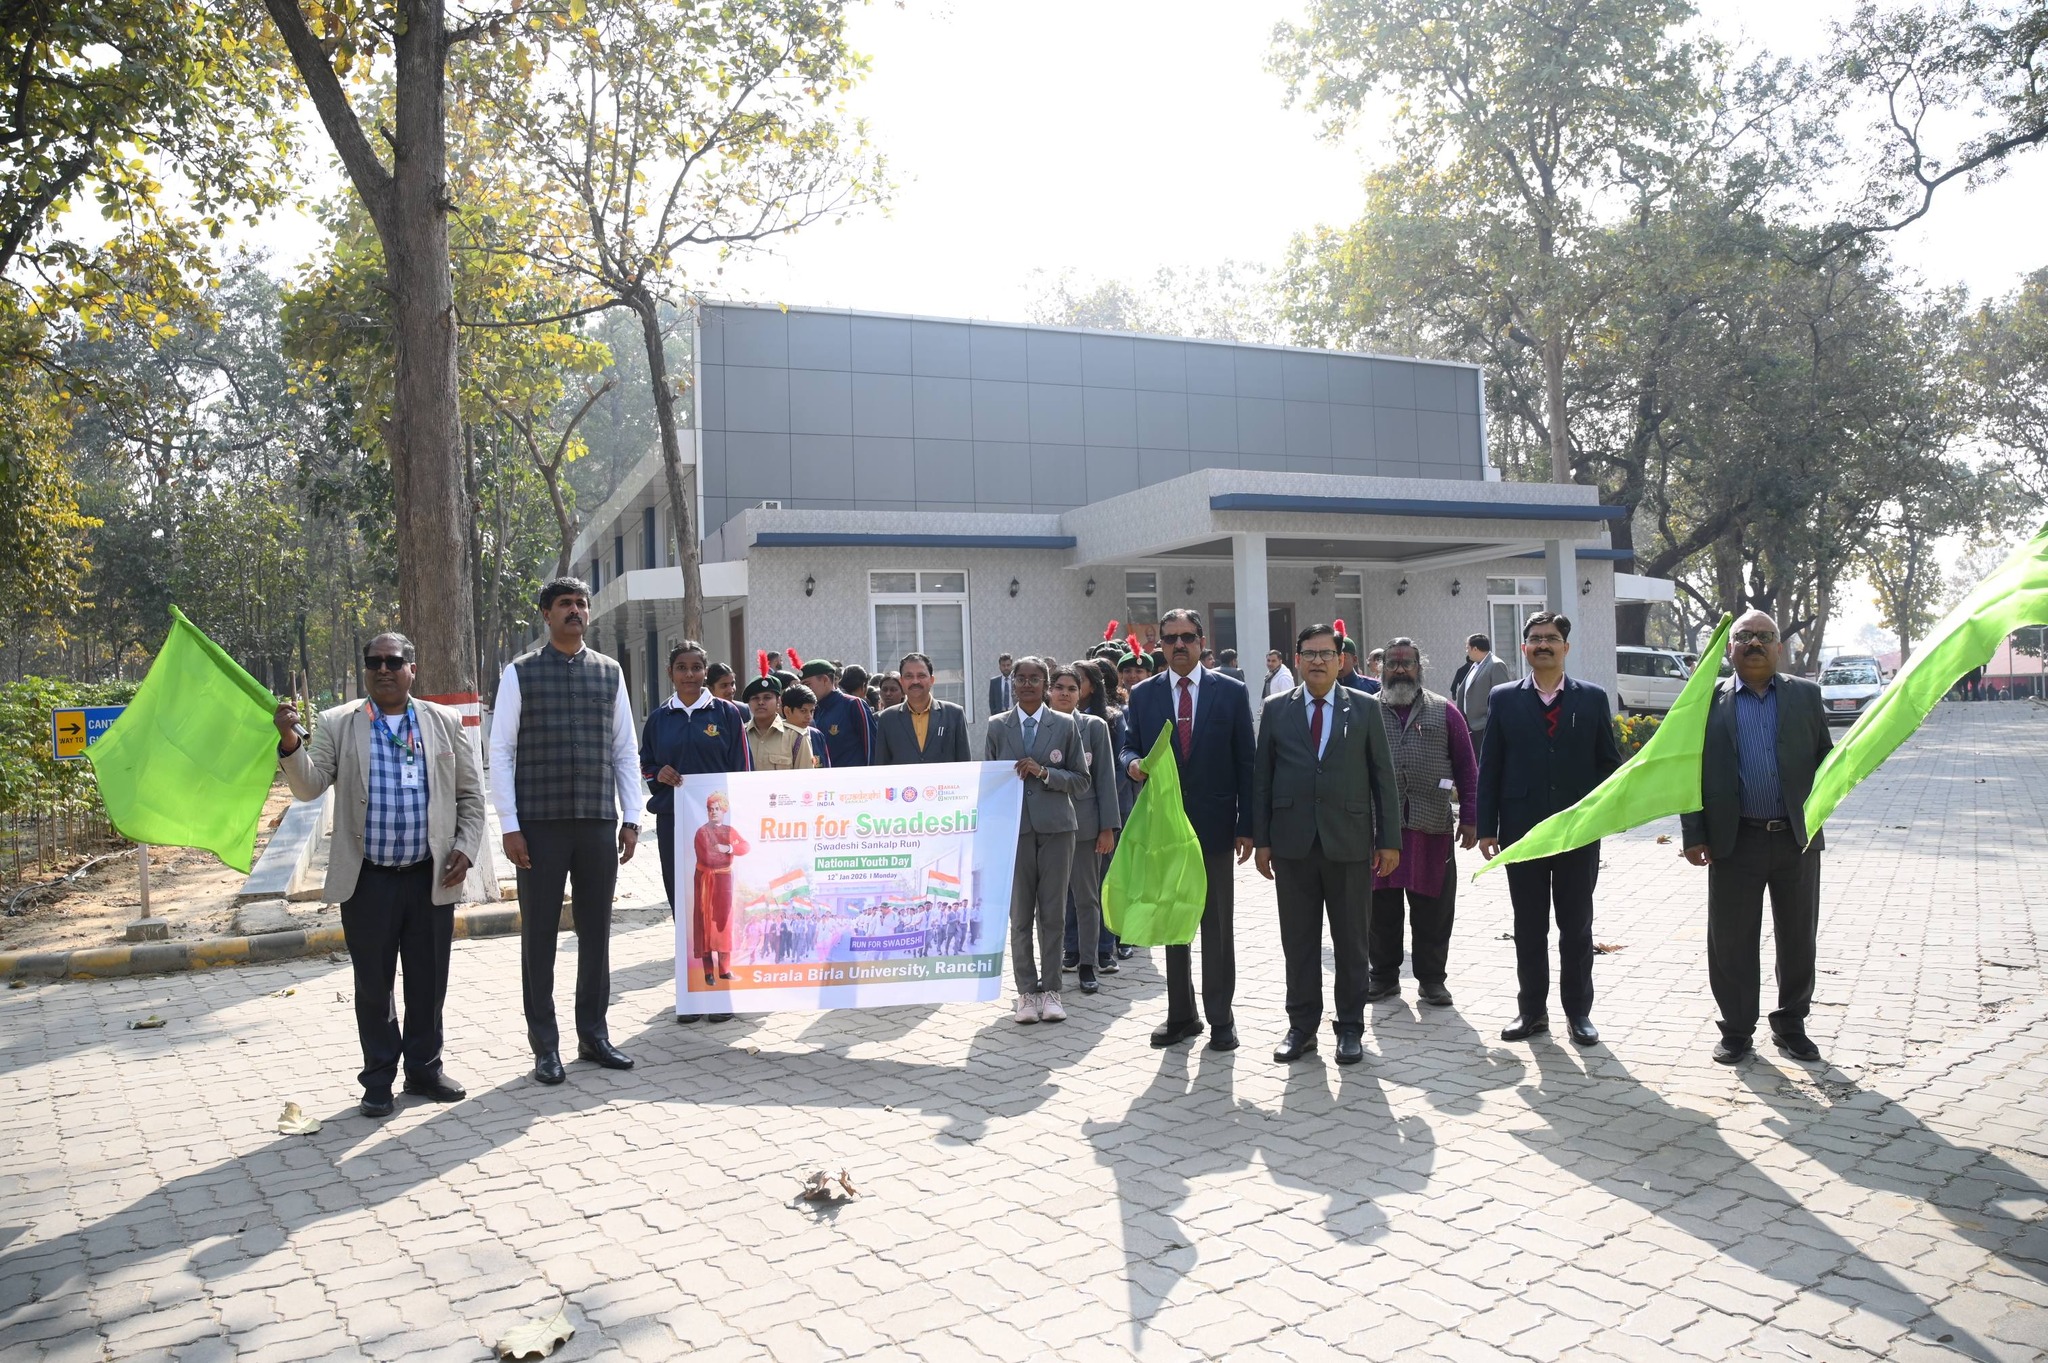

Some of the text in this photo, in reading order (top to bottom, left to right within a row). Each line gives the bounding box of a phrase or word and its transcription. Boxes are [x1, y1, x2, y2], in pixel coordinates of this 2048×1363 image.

[88, 718, 117, 729] CANT
[759, 808, 978, 840] Run for Swadeshi
[813, 839, 921, 853] (Swadeshi Sankalp Run)
[817, 856, 910, 869] National Youth Day
[851, 872, 867, 880] 2026
[851, 935, 923, 948] RUN FOR SWADESHI
[752, 959, 993, 983] Sarala Birla University, Ranchi
